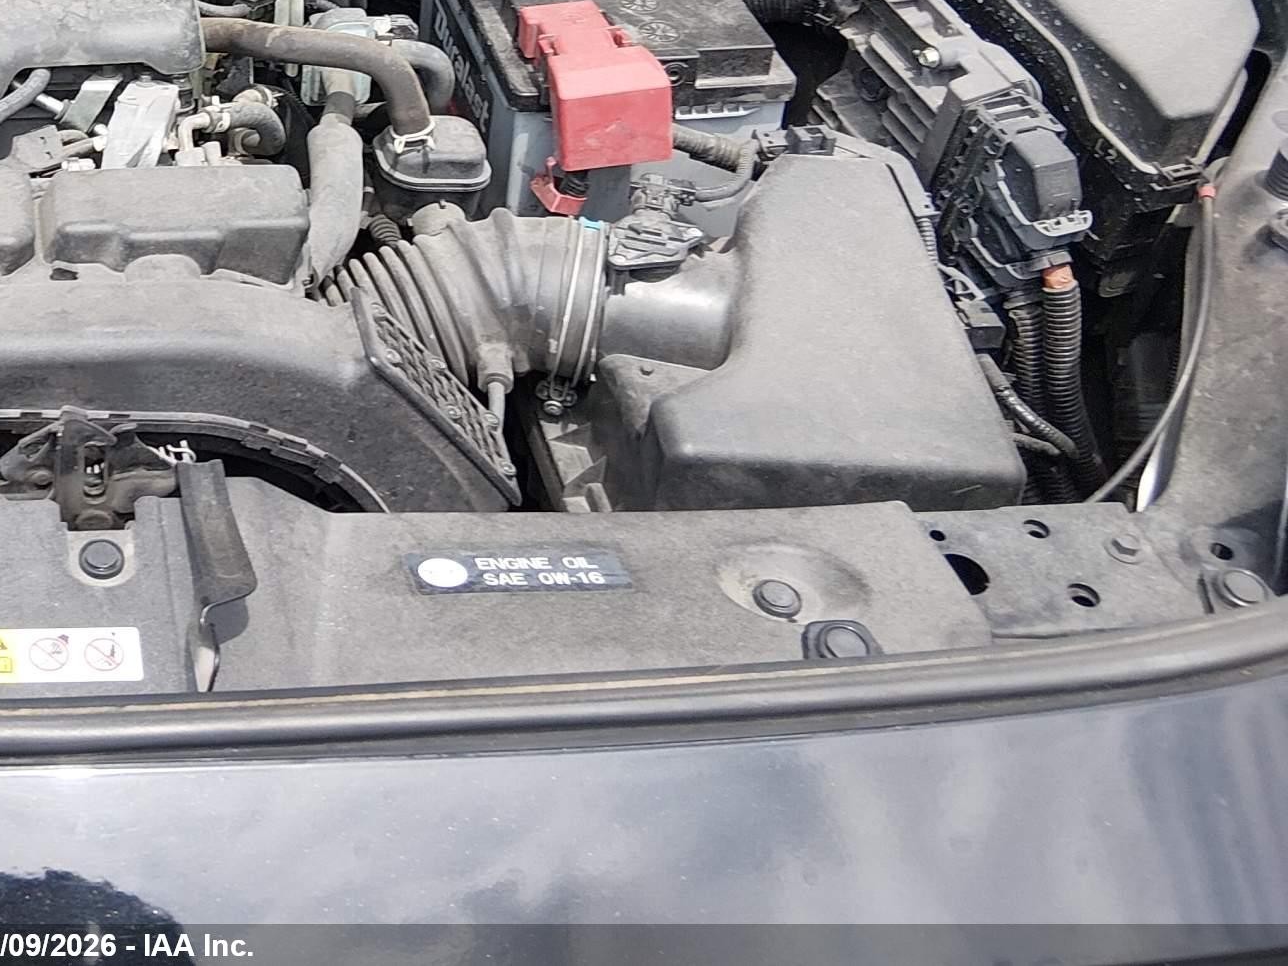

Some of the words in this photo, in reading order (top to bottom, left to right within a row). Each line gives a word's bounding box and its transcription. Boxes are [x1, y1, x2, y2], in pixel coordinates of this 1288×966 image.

[474, 557, 552, 570] ENGINE
[561, 557, 599, 570] OIL
[482, 572, 528, 586] SAE
[537, 572, 605, 585] 0W-16
